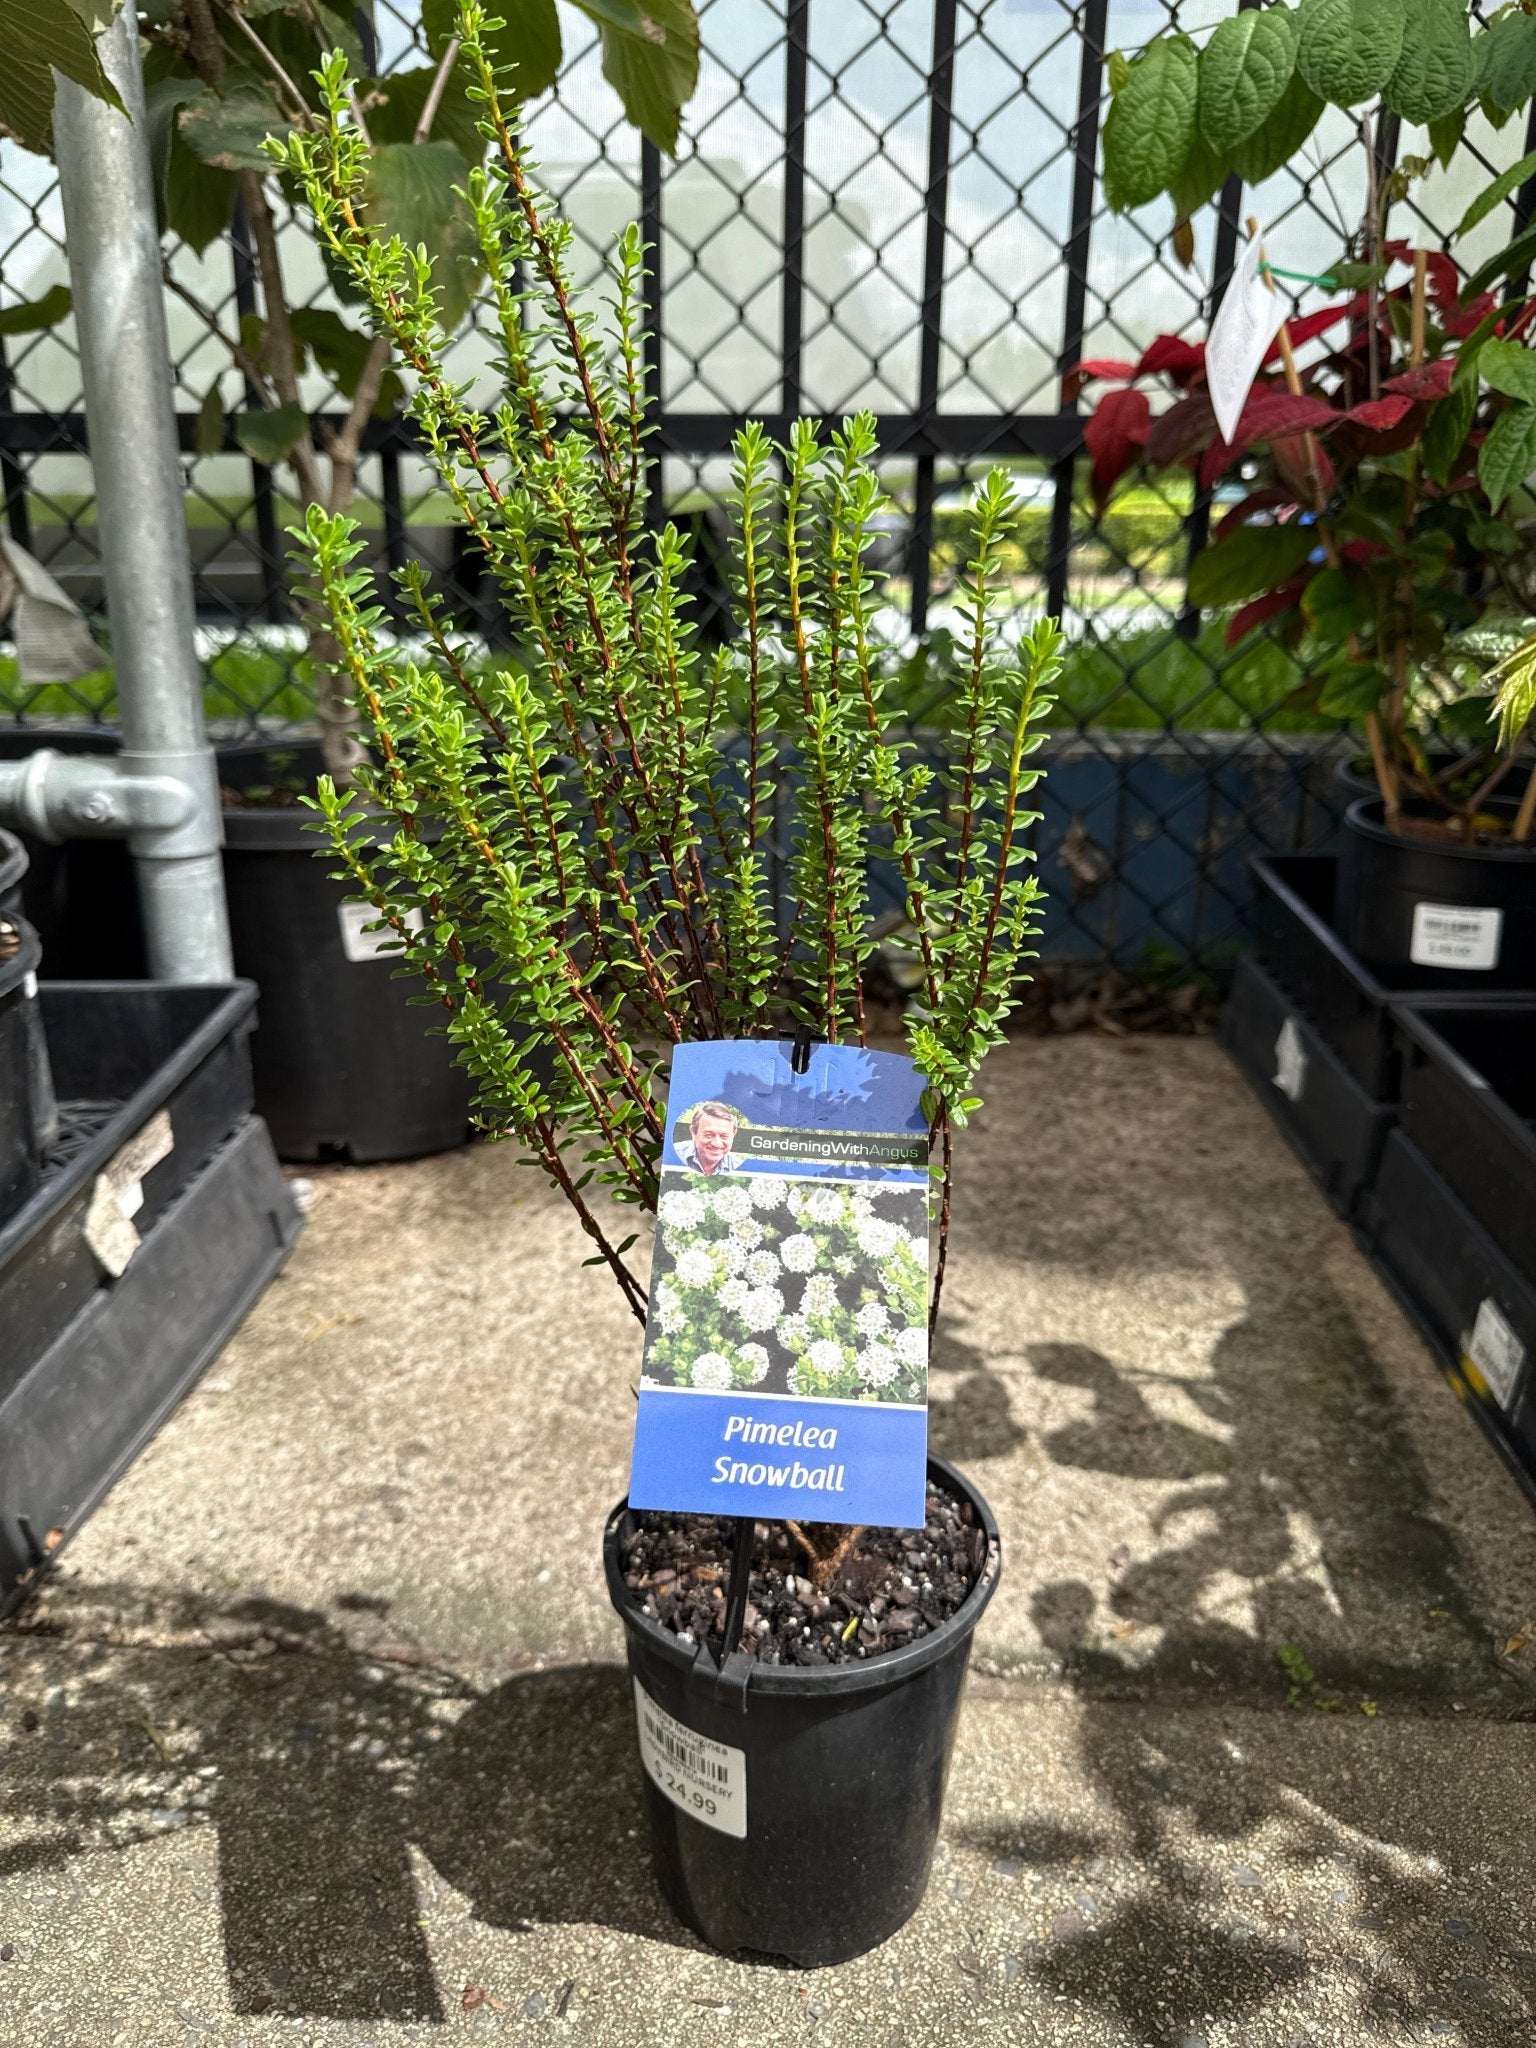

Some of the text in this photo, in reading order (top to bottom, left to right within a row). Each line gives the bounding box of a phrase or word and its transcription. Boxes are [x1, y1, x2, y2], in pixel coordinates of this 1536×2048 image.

[750, 1136, 919, 1160] GardeningWithAngus
[723, 1416, 838, 1450] Pimelea
[711, 1456, 845, 1492] Snowball
